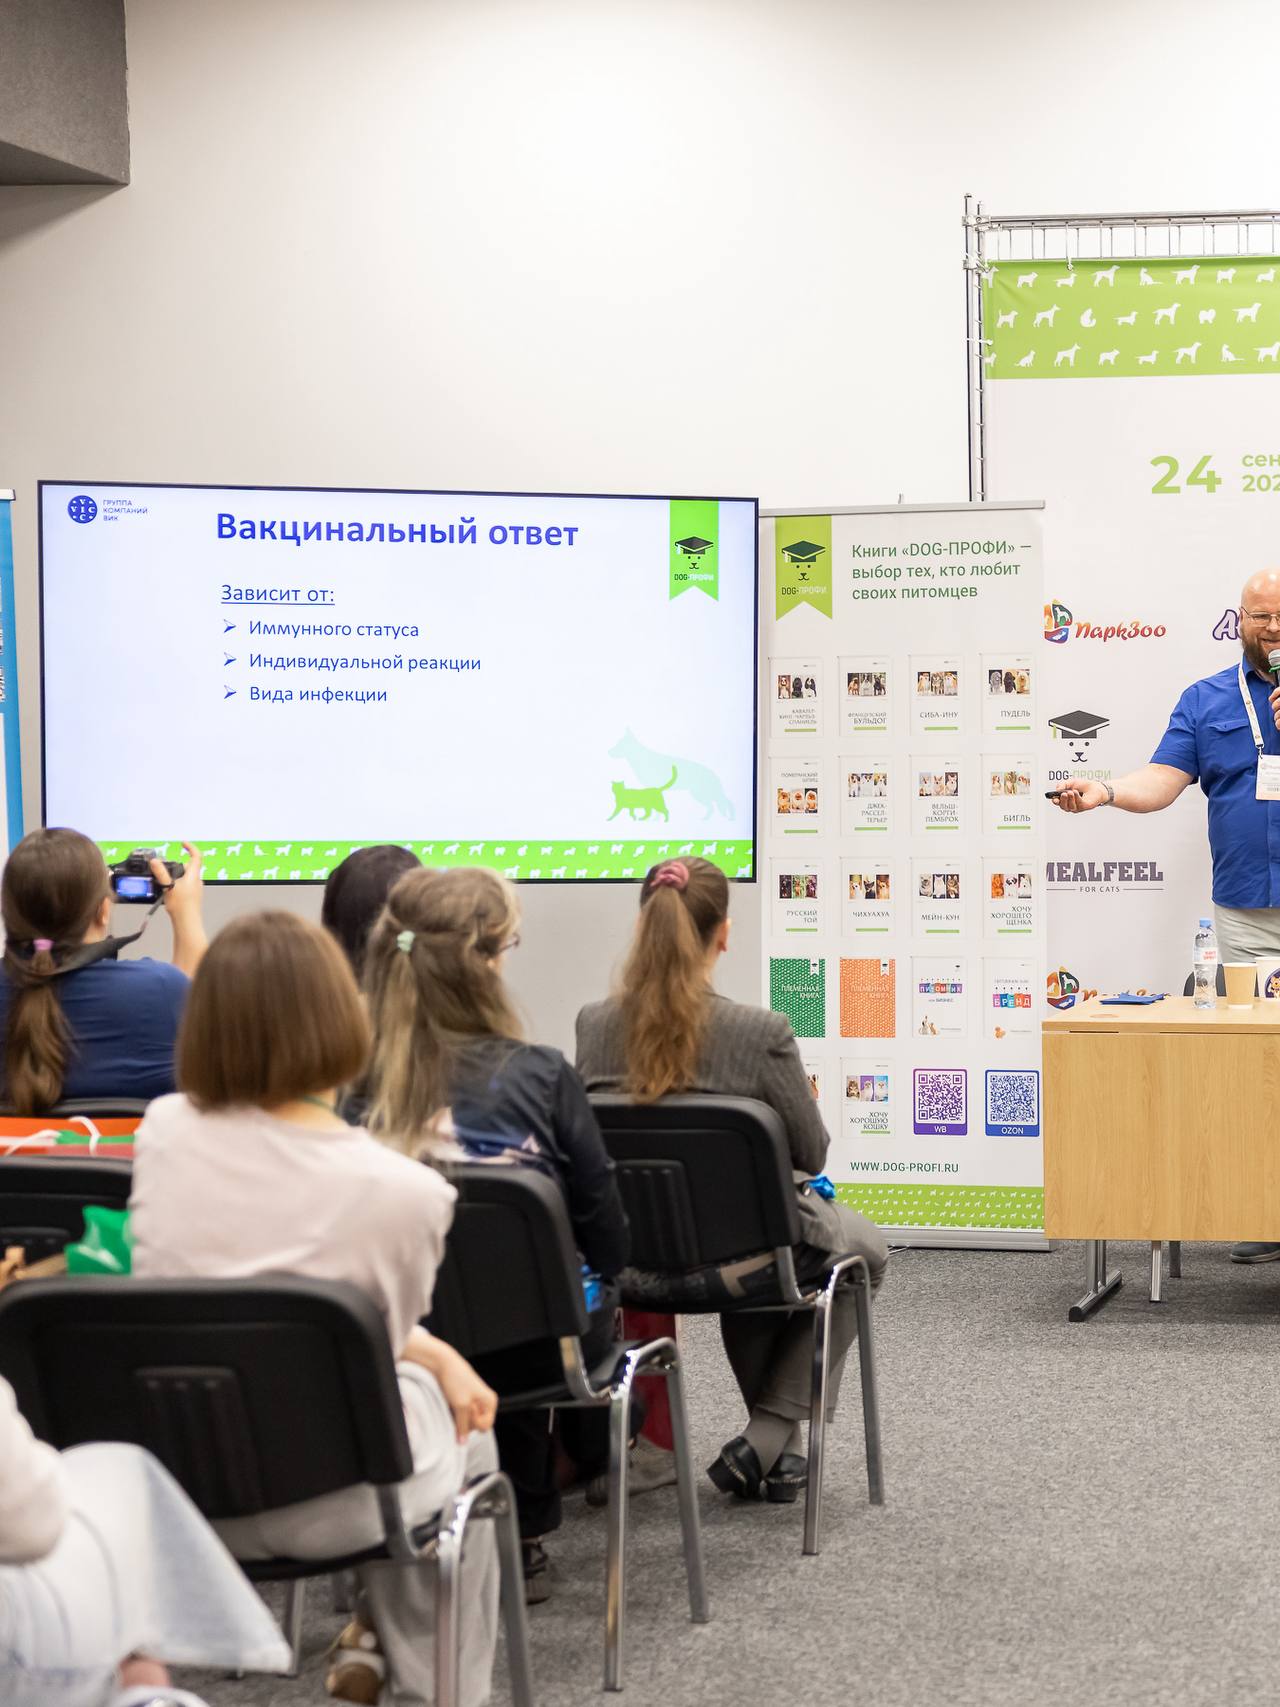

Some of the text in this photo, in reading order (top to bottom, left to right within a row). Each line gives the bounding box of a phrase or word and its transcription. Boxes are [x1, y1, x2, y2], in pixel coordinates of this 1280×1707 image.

[1150, 455, 1222, 494] 24
[216, 513, 579, 546] Вакцинальный ответ
[852, 545, 897, 558] Книги
[902, 541, 1015, 556] «DOG-ПРОФИ»
[852, 562, 1021, 581] выбор тех, кто любит
[221, 584, 335, 603] Зависит от:
[852, 587, 978, 600] своих питомцев
[250, 621, 419, 640] Иммунного статуса
[250, 653, 481, 672] Индивидуальной реакции
[250, 687, 387, 704] Вида инфекции
[1001, 710, 1031, 718] ПУДЕЛЬ
[1003, 814, 1031, 822] БИГЛЬ
[993, 998, 1031, 1007] БРЕНД
[1001, 1127, 1024, 1135] OZON
[850, 1162, 959, 1173] WWW.DOG-PROFI.RU
